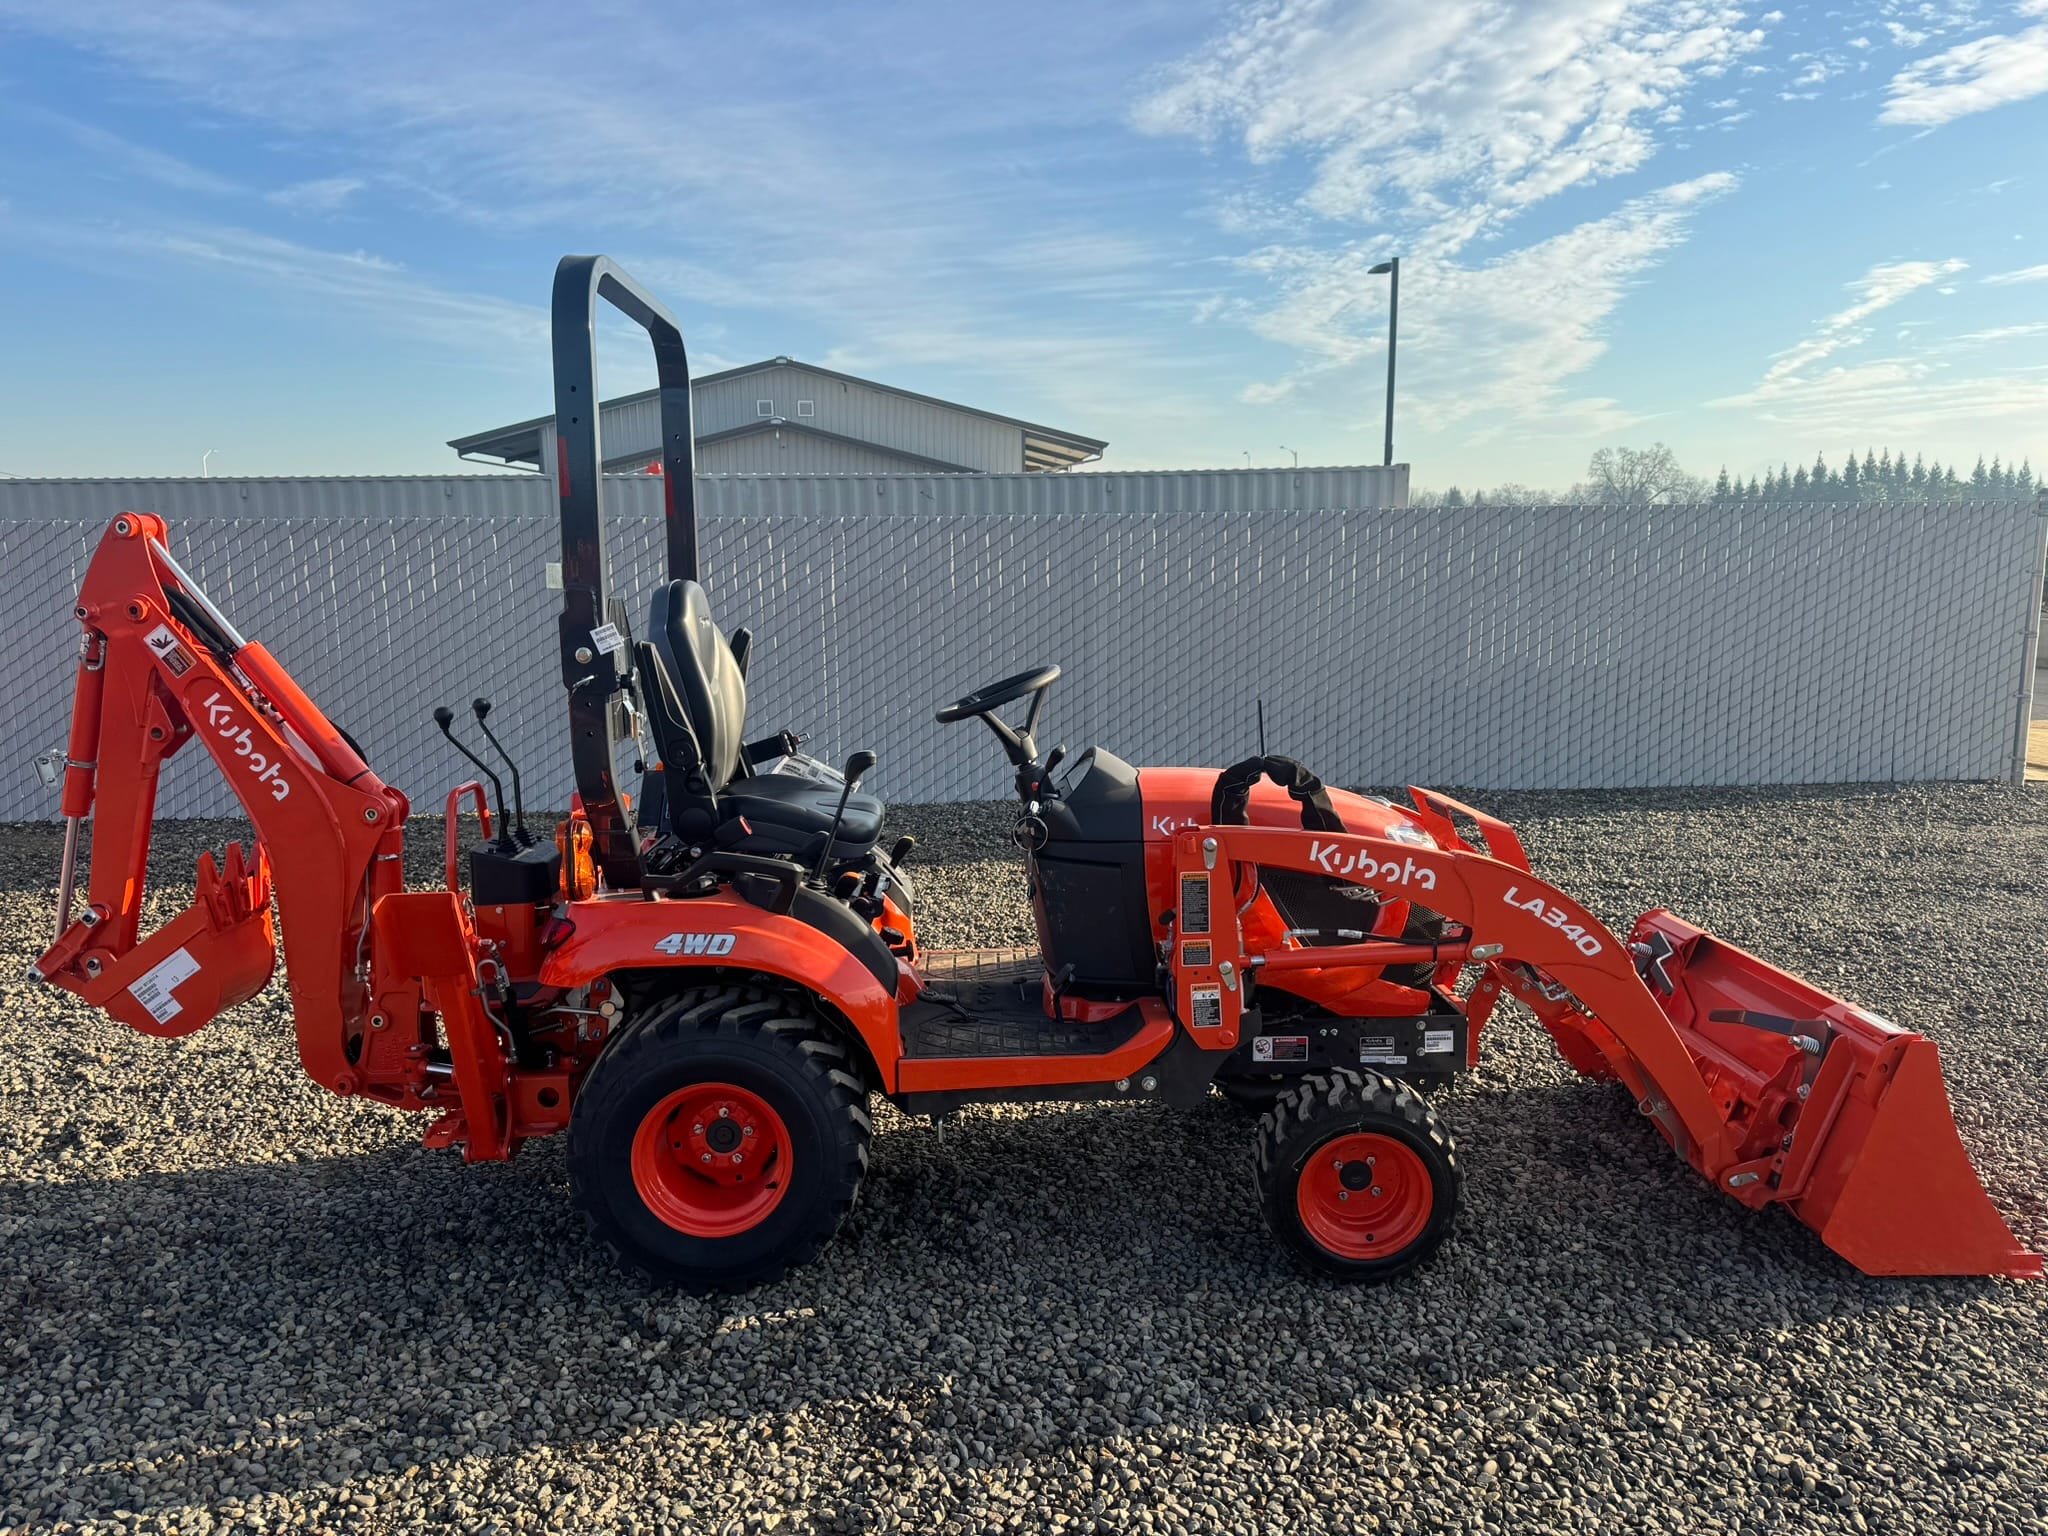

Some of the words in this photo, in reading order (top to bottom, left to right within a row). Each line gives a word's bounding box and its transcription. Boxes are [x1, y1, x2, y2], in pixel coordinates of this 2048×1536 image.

[203, 692, 290, 801] Kubota
[1309, 841, 1437, 890] Kubota
[654, 933, 736, 955] 4WD
[1503, 886, 1602, 956] LA340
